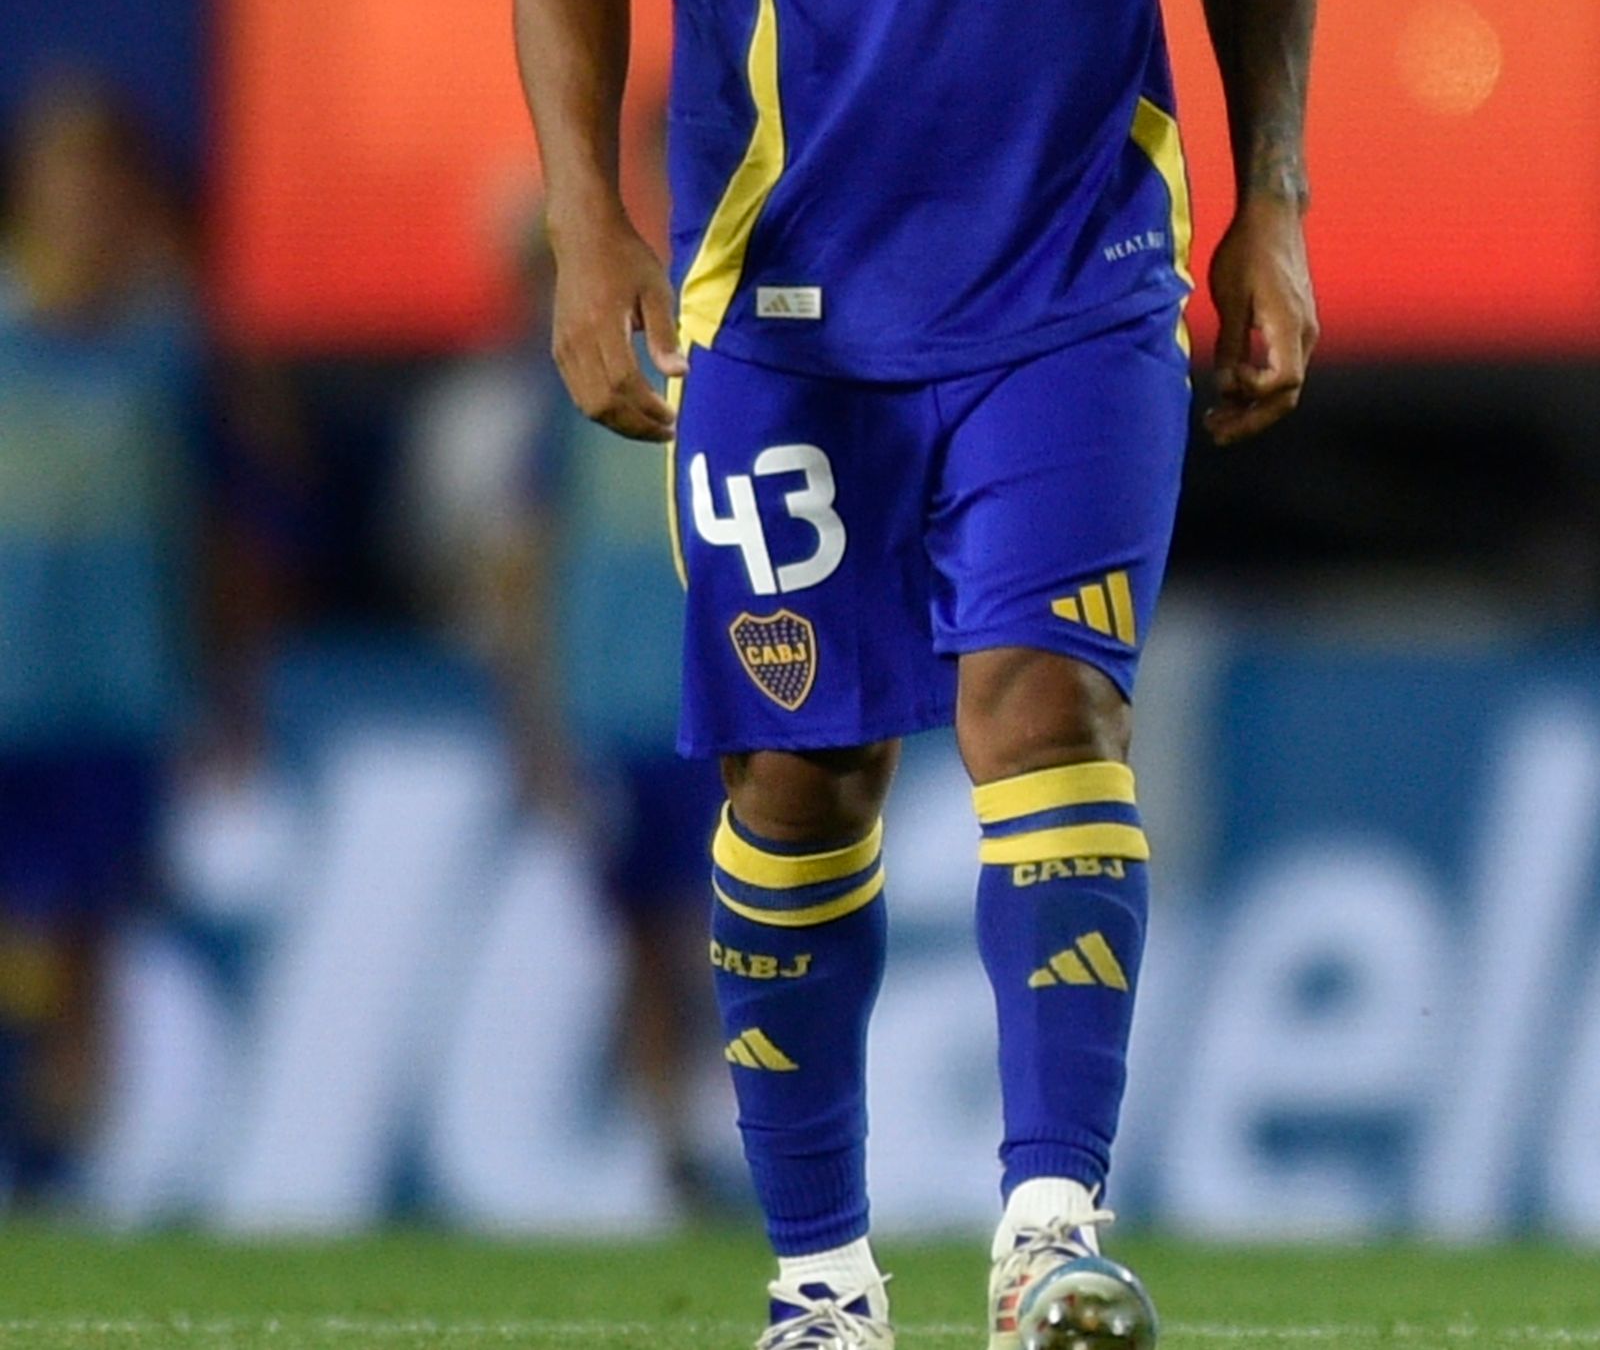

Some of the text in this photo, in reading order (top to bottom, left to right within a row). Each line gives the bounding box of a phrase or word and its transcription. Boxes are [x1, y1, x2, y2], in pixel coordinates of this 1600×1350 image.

[690, 444, 847, 596] 43
[747, 641, 807, 666] CABJ
[1013, 857, 1125, 887] CABJ
